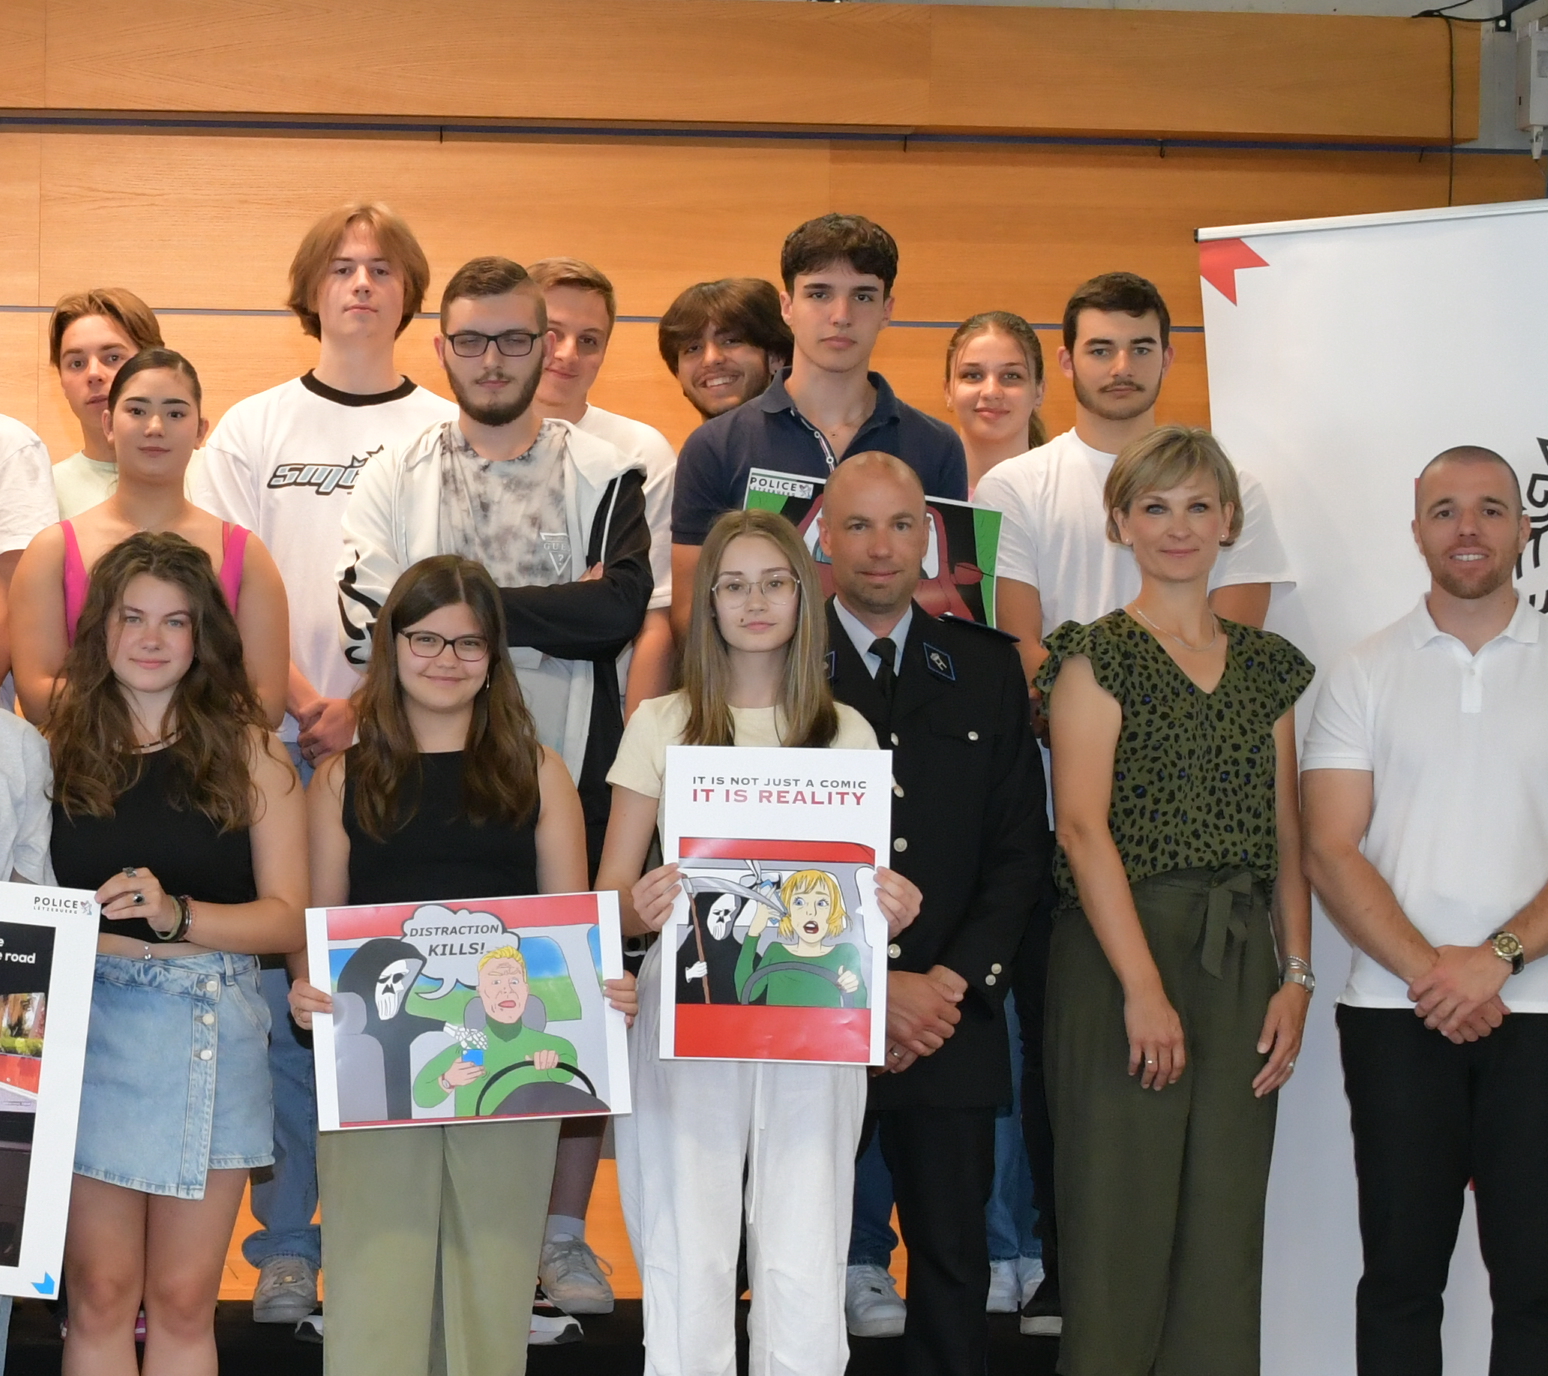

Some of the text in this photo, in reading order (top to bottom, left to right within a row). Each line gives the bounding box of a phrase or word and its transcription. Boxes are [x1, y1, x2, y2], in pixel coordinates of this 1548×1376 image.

[750, 477, 797, 491] POLICE
[692, 776, 867, 789] IT IS NOT JUST A COMIC
[692, 788, 866, 806] IT IS REALITY
[33, 896, 78, 909] POLICE
[409, 924, 499, 937] DISTRACTION
[428, 942, 485, 957] KILLS!
[4, 952, 36, 964] road
